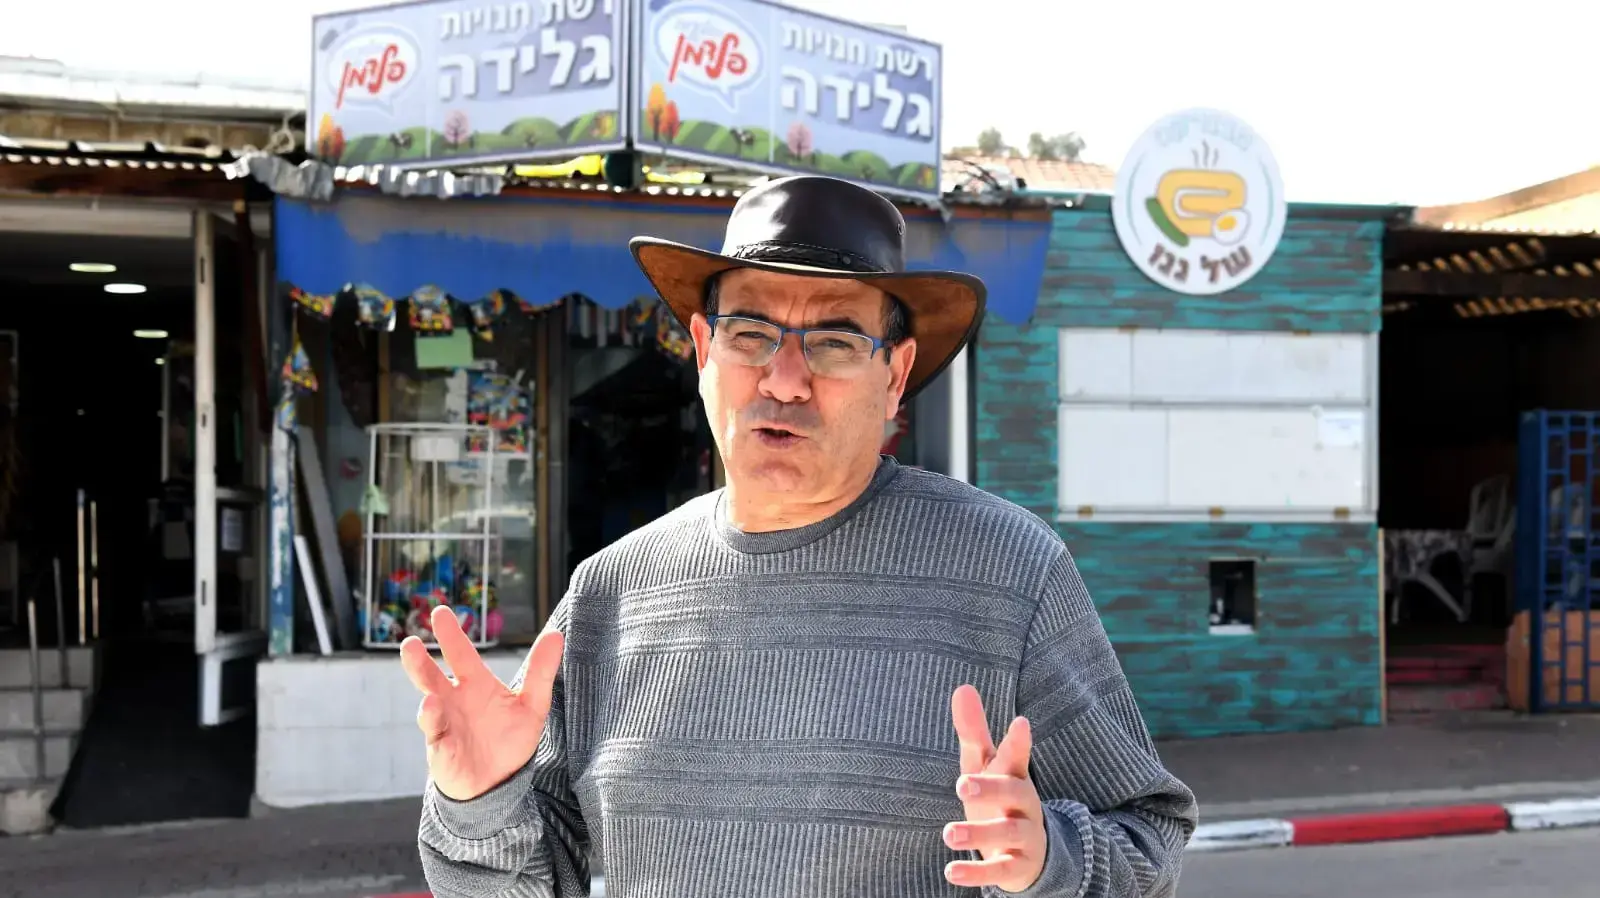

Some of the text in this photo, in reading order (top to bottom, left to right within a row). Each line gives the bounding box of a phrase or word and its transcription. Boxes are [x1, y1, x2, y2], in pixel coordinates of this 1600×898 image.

[440, 4, 531, 40] חנויות
[781, 20, 932, 81] רשת חנויות
[336, 44, 407, 109] פלדמן
[436, 28, 613, 102] גלידה
[668, 33, 748, 83] פלדמן
[781, 65, 932, 138] גלידה
[1200, 245, 1252, 283] של
